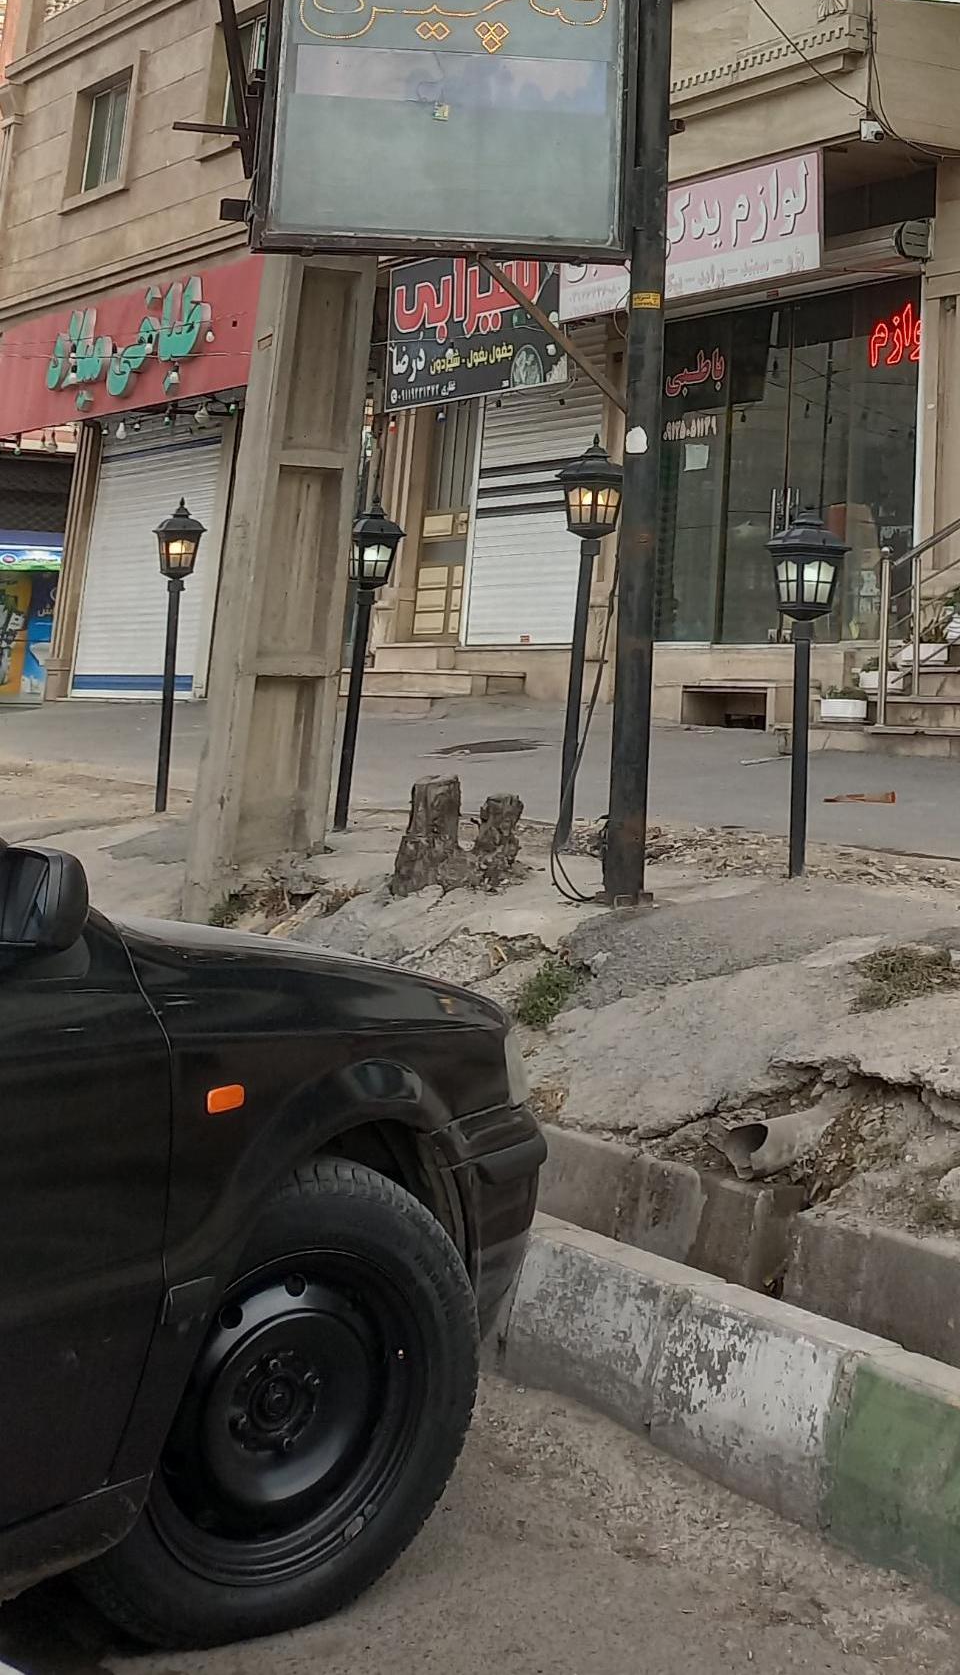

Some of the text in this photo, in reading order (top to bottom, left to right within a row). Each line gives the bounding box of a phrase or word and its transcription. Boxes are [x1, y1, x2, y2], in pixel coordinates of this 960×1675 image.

[666, 161, 809, 259] لوازم یدک
[869, 303, 921, 367] وازم
[666, 348, 725, 398] باطبی
